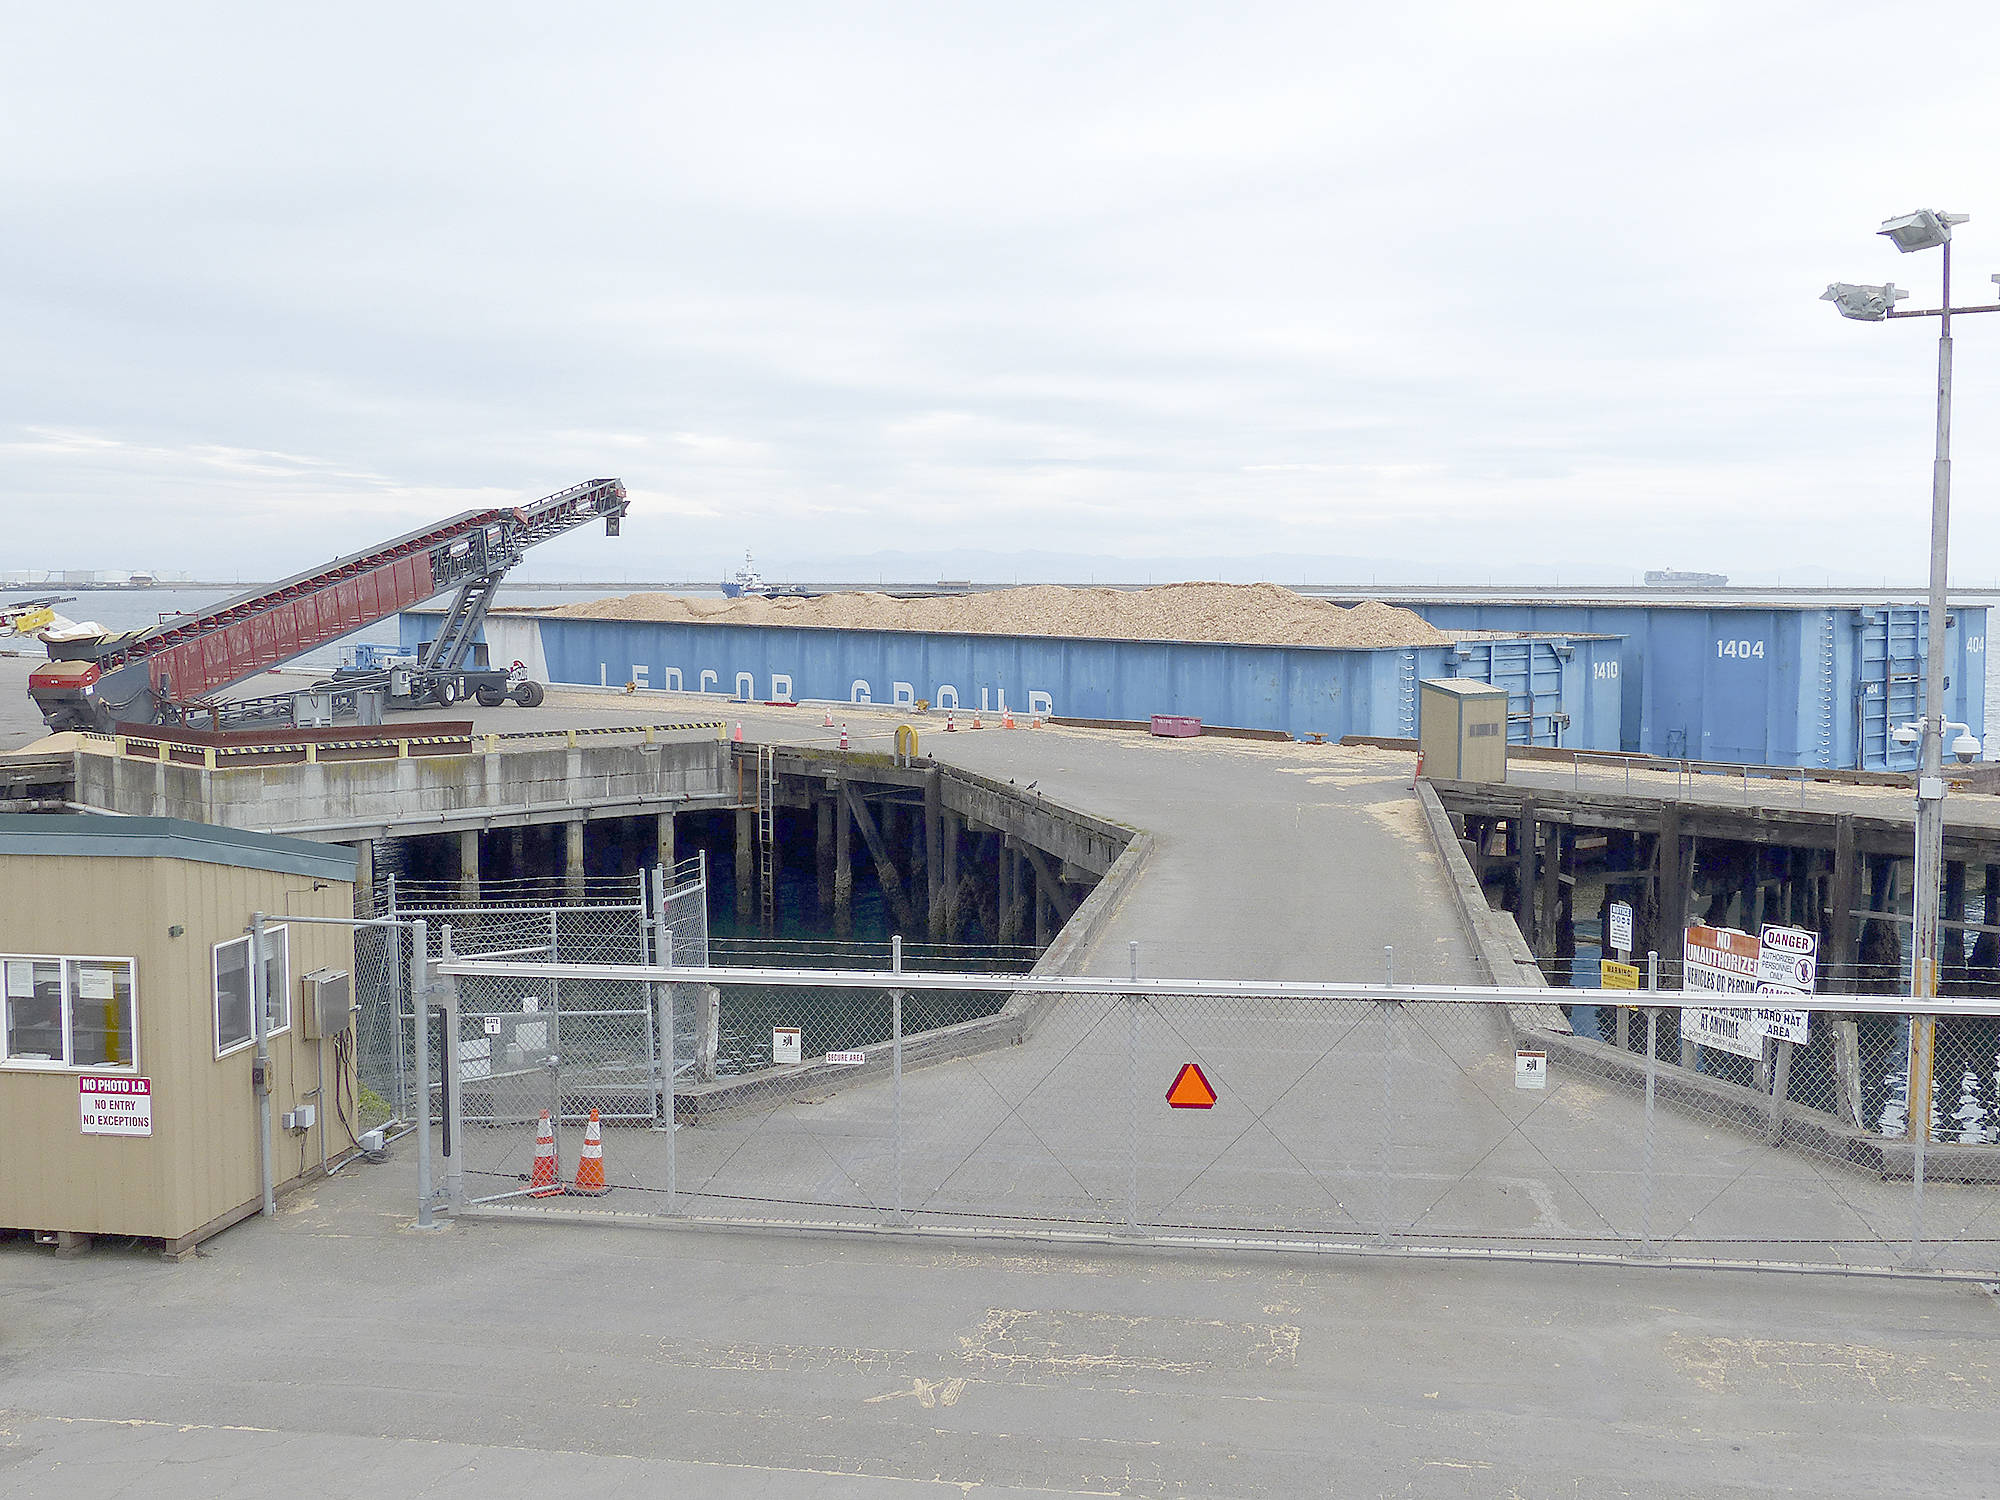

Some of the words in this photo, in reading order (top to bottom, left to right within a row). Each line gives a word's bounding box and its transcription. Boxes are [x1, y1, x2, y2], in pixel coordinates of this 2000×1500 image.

[1716, 639, 1765, 659] 1404
[1593, 661, 1618, 680] 1410
[851, 679, 1053, 716] GROUP
[1716, 931, 1731, 950] NO
[1768, 931, 1809, 950] DANGER
[1762, 951, 1796, 965] AUTHORIZED
[1762, 960, 1793, 974] PERSONNEL
[1687, 966, 1716, 990] VEHICLES
[1716, 973, 1726, 993] OR
[1770, 971, 1783, 981] ONLY
[1757, 1008, 1782, 1023] HARD
[1783, 1013, 1801, 1027] HAT
[490, 1024, 495, 1032] 1
[1701, 1013, 1709, 1031] AT
[1709, 1015, 1739, 1040] ANYTIME
[1766, 1023, 1790, 1039] AREA
[827, 1053, 846, 1062] SECURE
[849, 1053, 864, 1062] AREA
[82, 1078, 96, 1091] NO
[98, 1080, 129, 1092] PHOTO
[131, 1081, 148, 1093] I.D.
[94, 1099, 107, 1110] NO
[109, 1100, 136, 1111] ENTRY
[83, 1114, 95, 1125] NO
[97, 1115, 149, 1128] EXCEPTIONS
